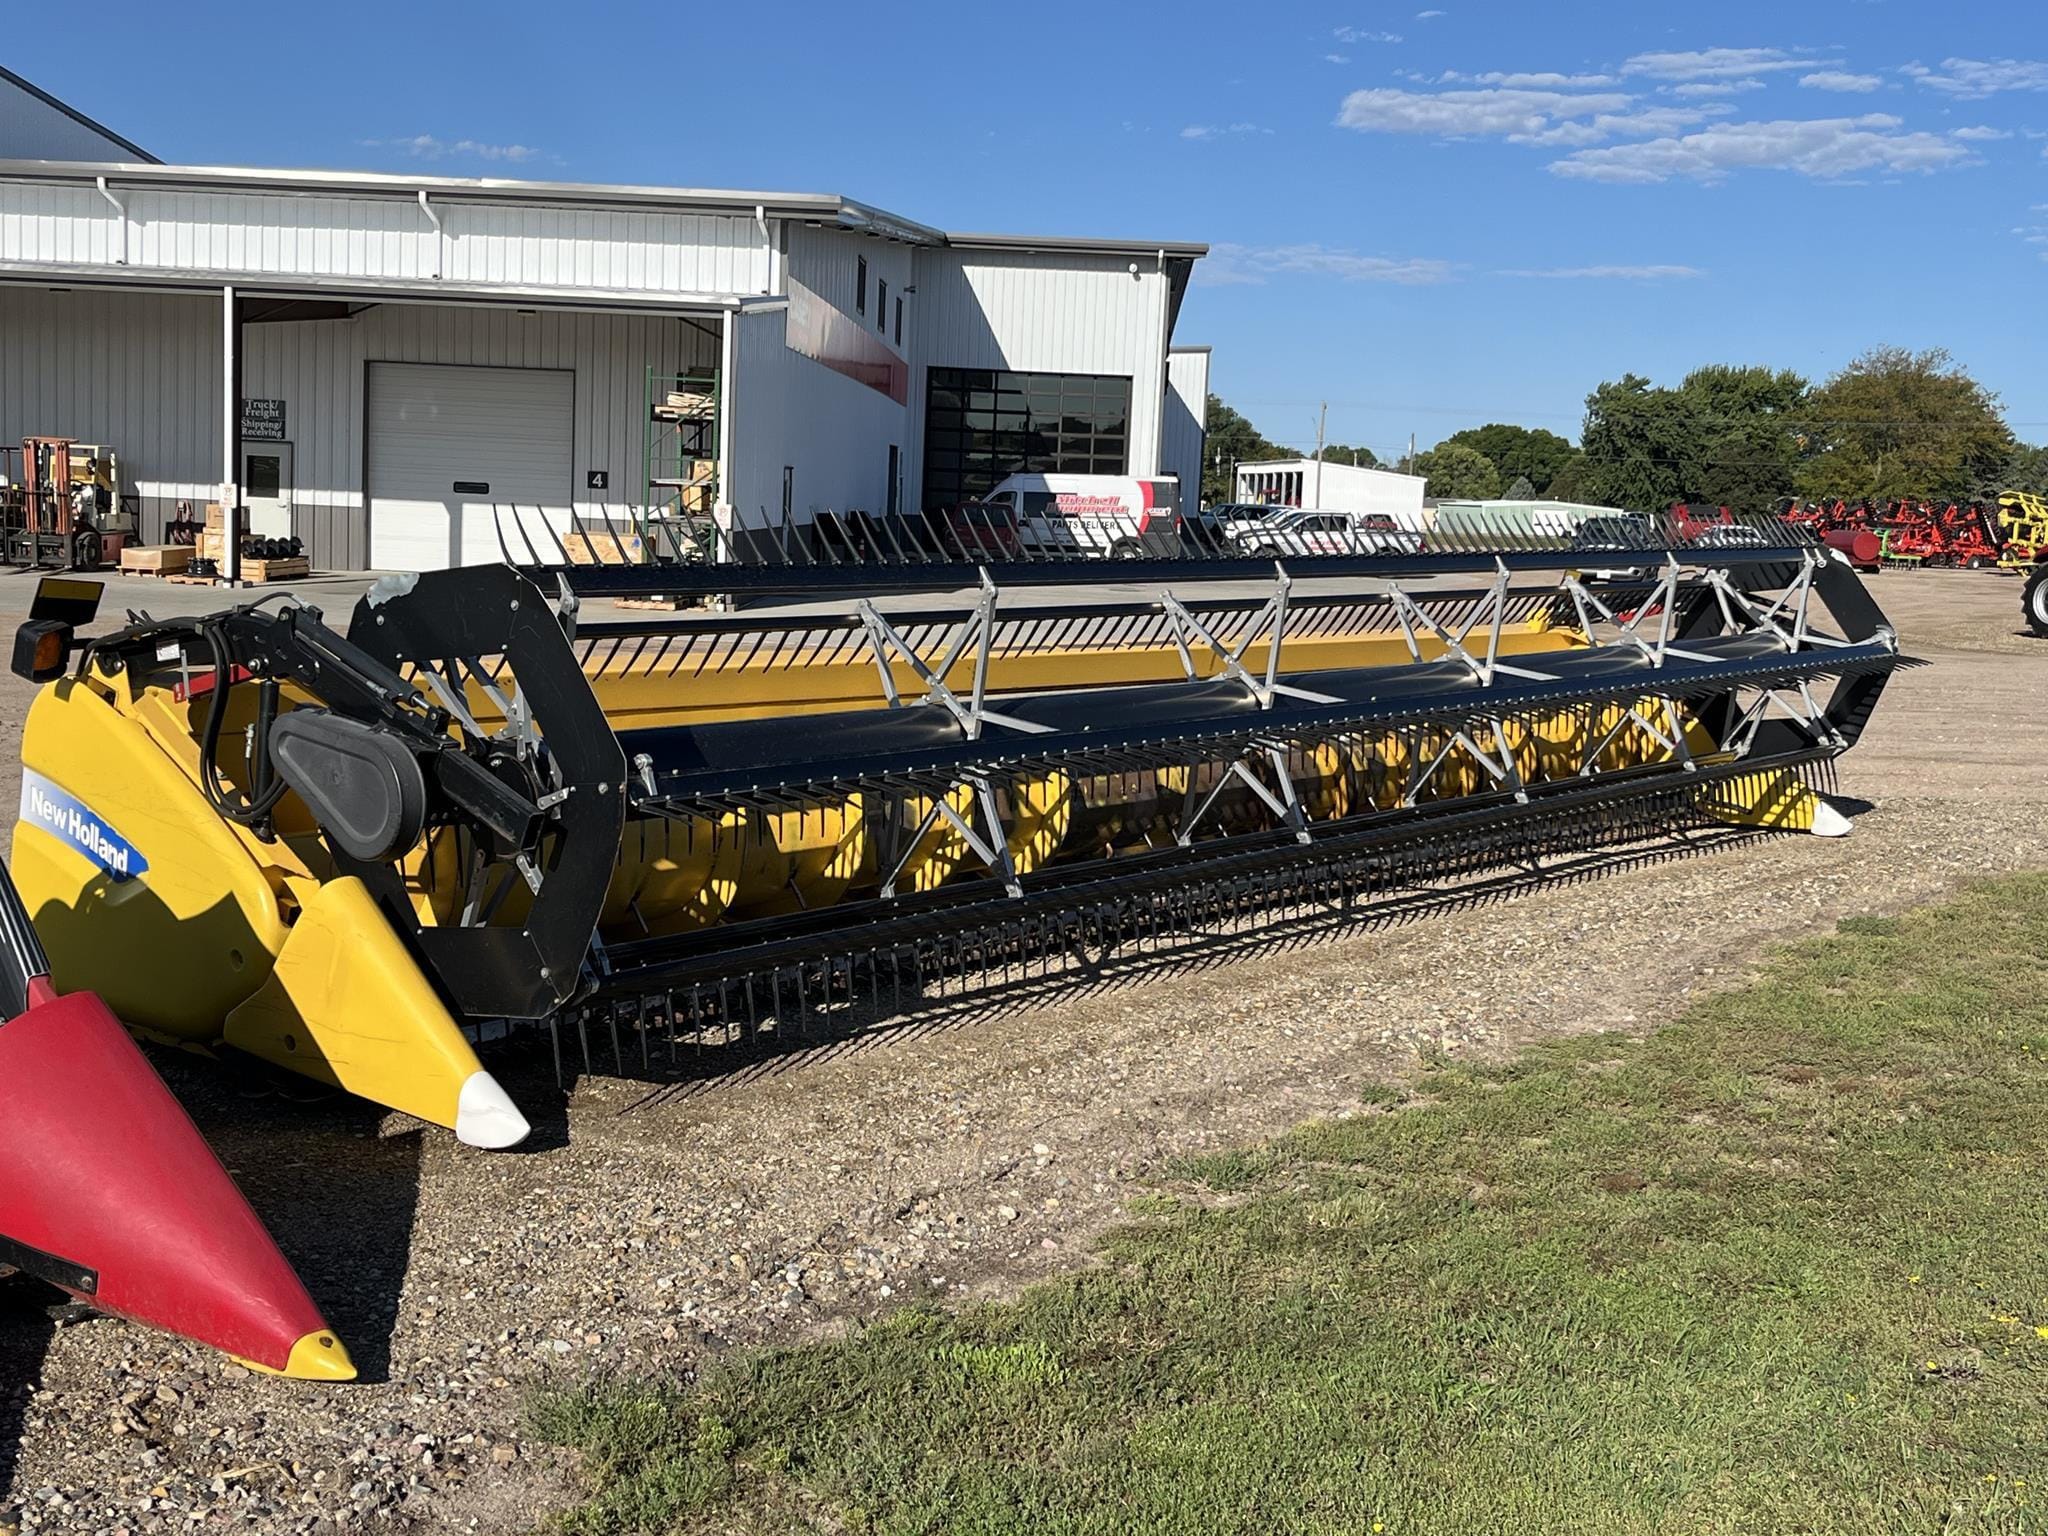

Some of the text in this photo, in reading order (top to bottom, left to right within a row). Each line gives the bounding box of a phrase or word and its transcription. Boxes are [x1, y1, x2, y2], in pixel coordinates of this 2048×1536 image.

[245, 399, 279, 409] Truck/
[245, 408, 279, 420] Freight
[241, 419, 282, 431] Shipping/
[241, 428, 282, 439] Receiving
[592, 473, 603, 488] 4
[1052, 520, 1078, 529] PATS
[31, 786, 128, 873] New Holland
